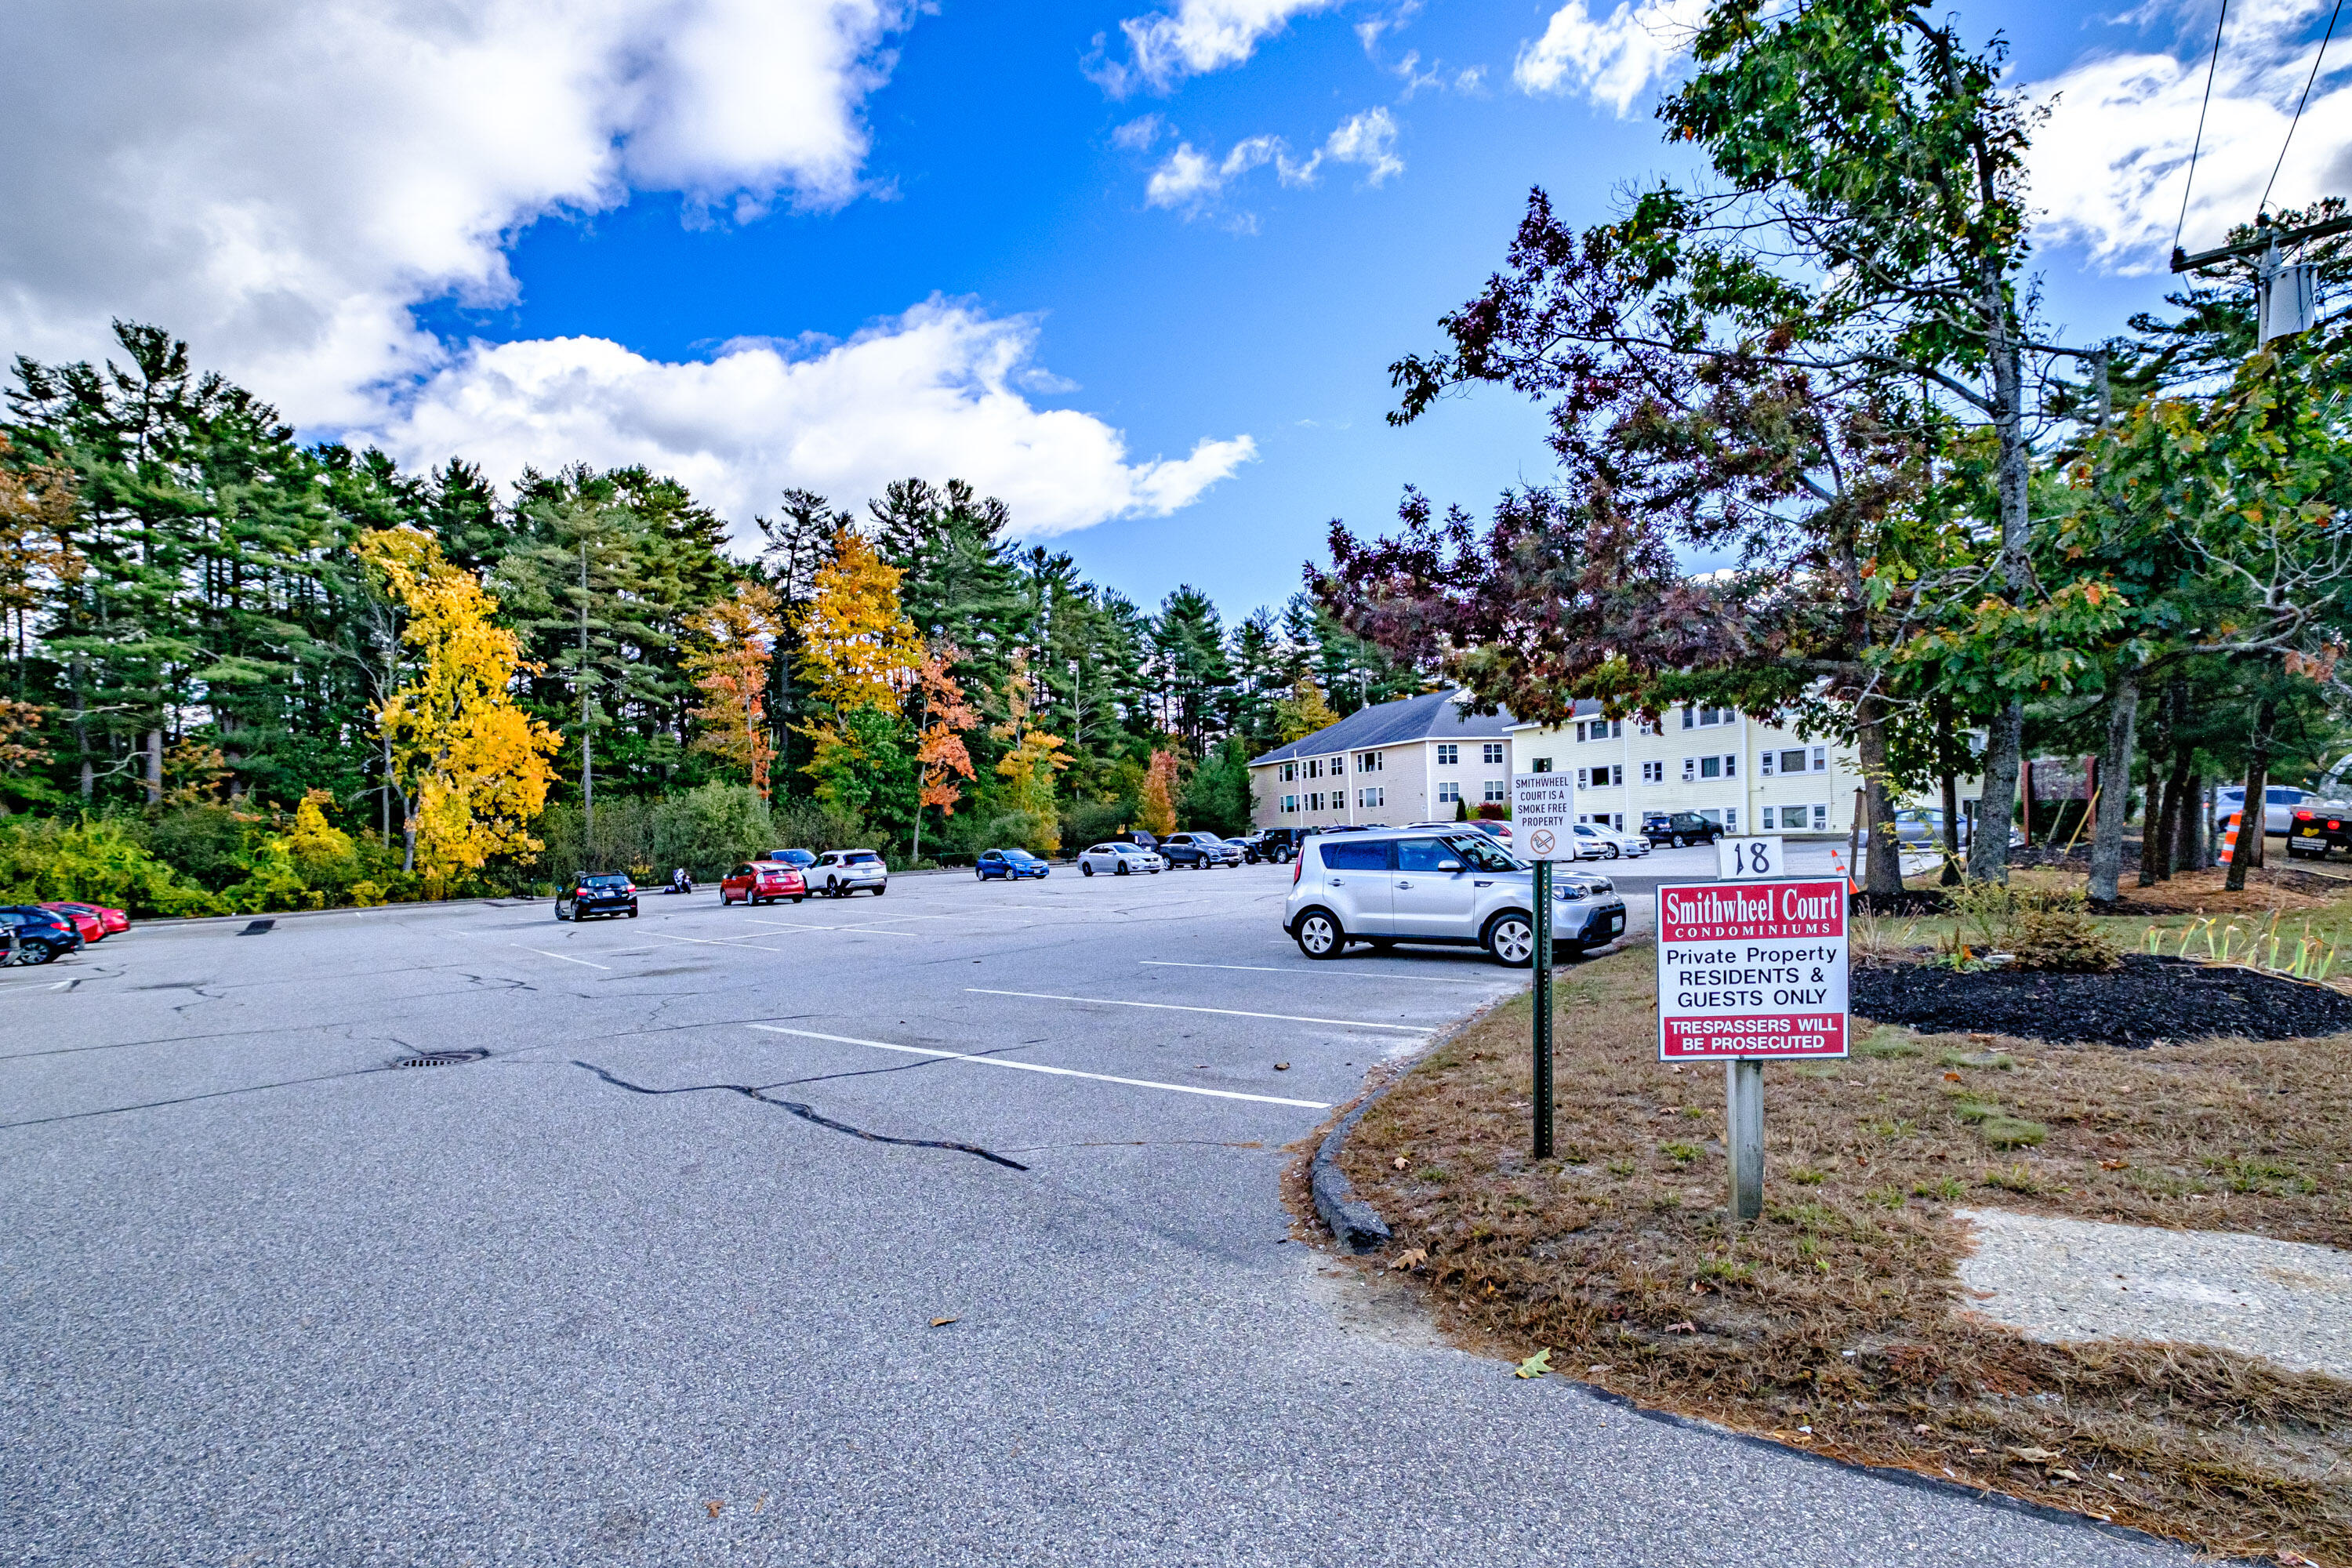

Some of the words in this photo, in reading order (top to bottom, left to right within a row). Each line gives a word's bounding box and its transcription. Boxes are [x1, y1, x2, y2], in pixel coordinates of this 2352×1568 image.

[1515, 777, 1569, 789] SMITHWHEEL
[1520, 791, 1546, 800] COURT
[1549, 790, 1556, 800] IS
[1559, 790, 1564, 799] A
[1518, 804, 1545, 814] SMOKE
[1548, 803, 1567, 813] FREE
[1522, 816, 1563, 826] PROPERTY
[1734, 842, 1769, 876] 18
[1667, 889, 1774, 925] Smithwheel
[1782, 888, 1837, 921] Court
[1675, 923, 1830, 938] CONDOMINIUMS
[1667, 948, 1737, 965] Private
[1747, 946, 1837, 965] Property
[1679, 967, 1799, 986] RESIDENTS
[1810, 967, 1824, 982] &
[1678, 990, 1763, 1007] GUESTS
[1773, 989, 1828, 1006] ONLY
[1670, 1018, 1791, 1035] TRESPASSERS
[1798, 1018, 1838, 1032] WILL
[1682, 1037, 1704, 1051] BE
[1711, 1035, 1825, 1051] PROSECUTED
